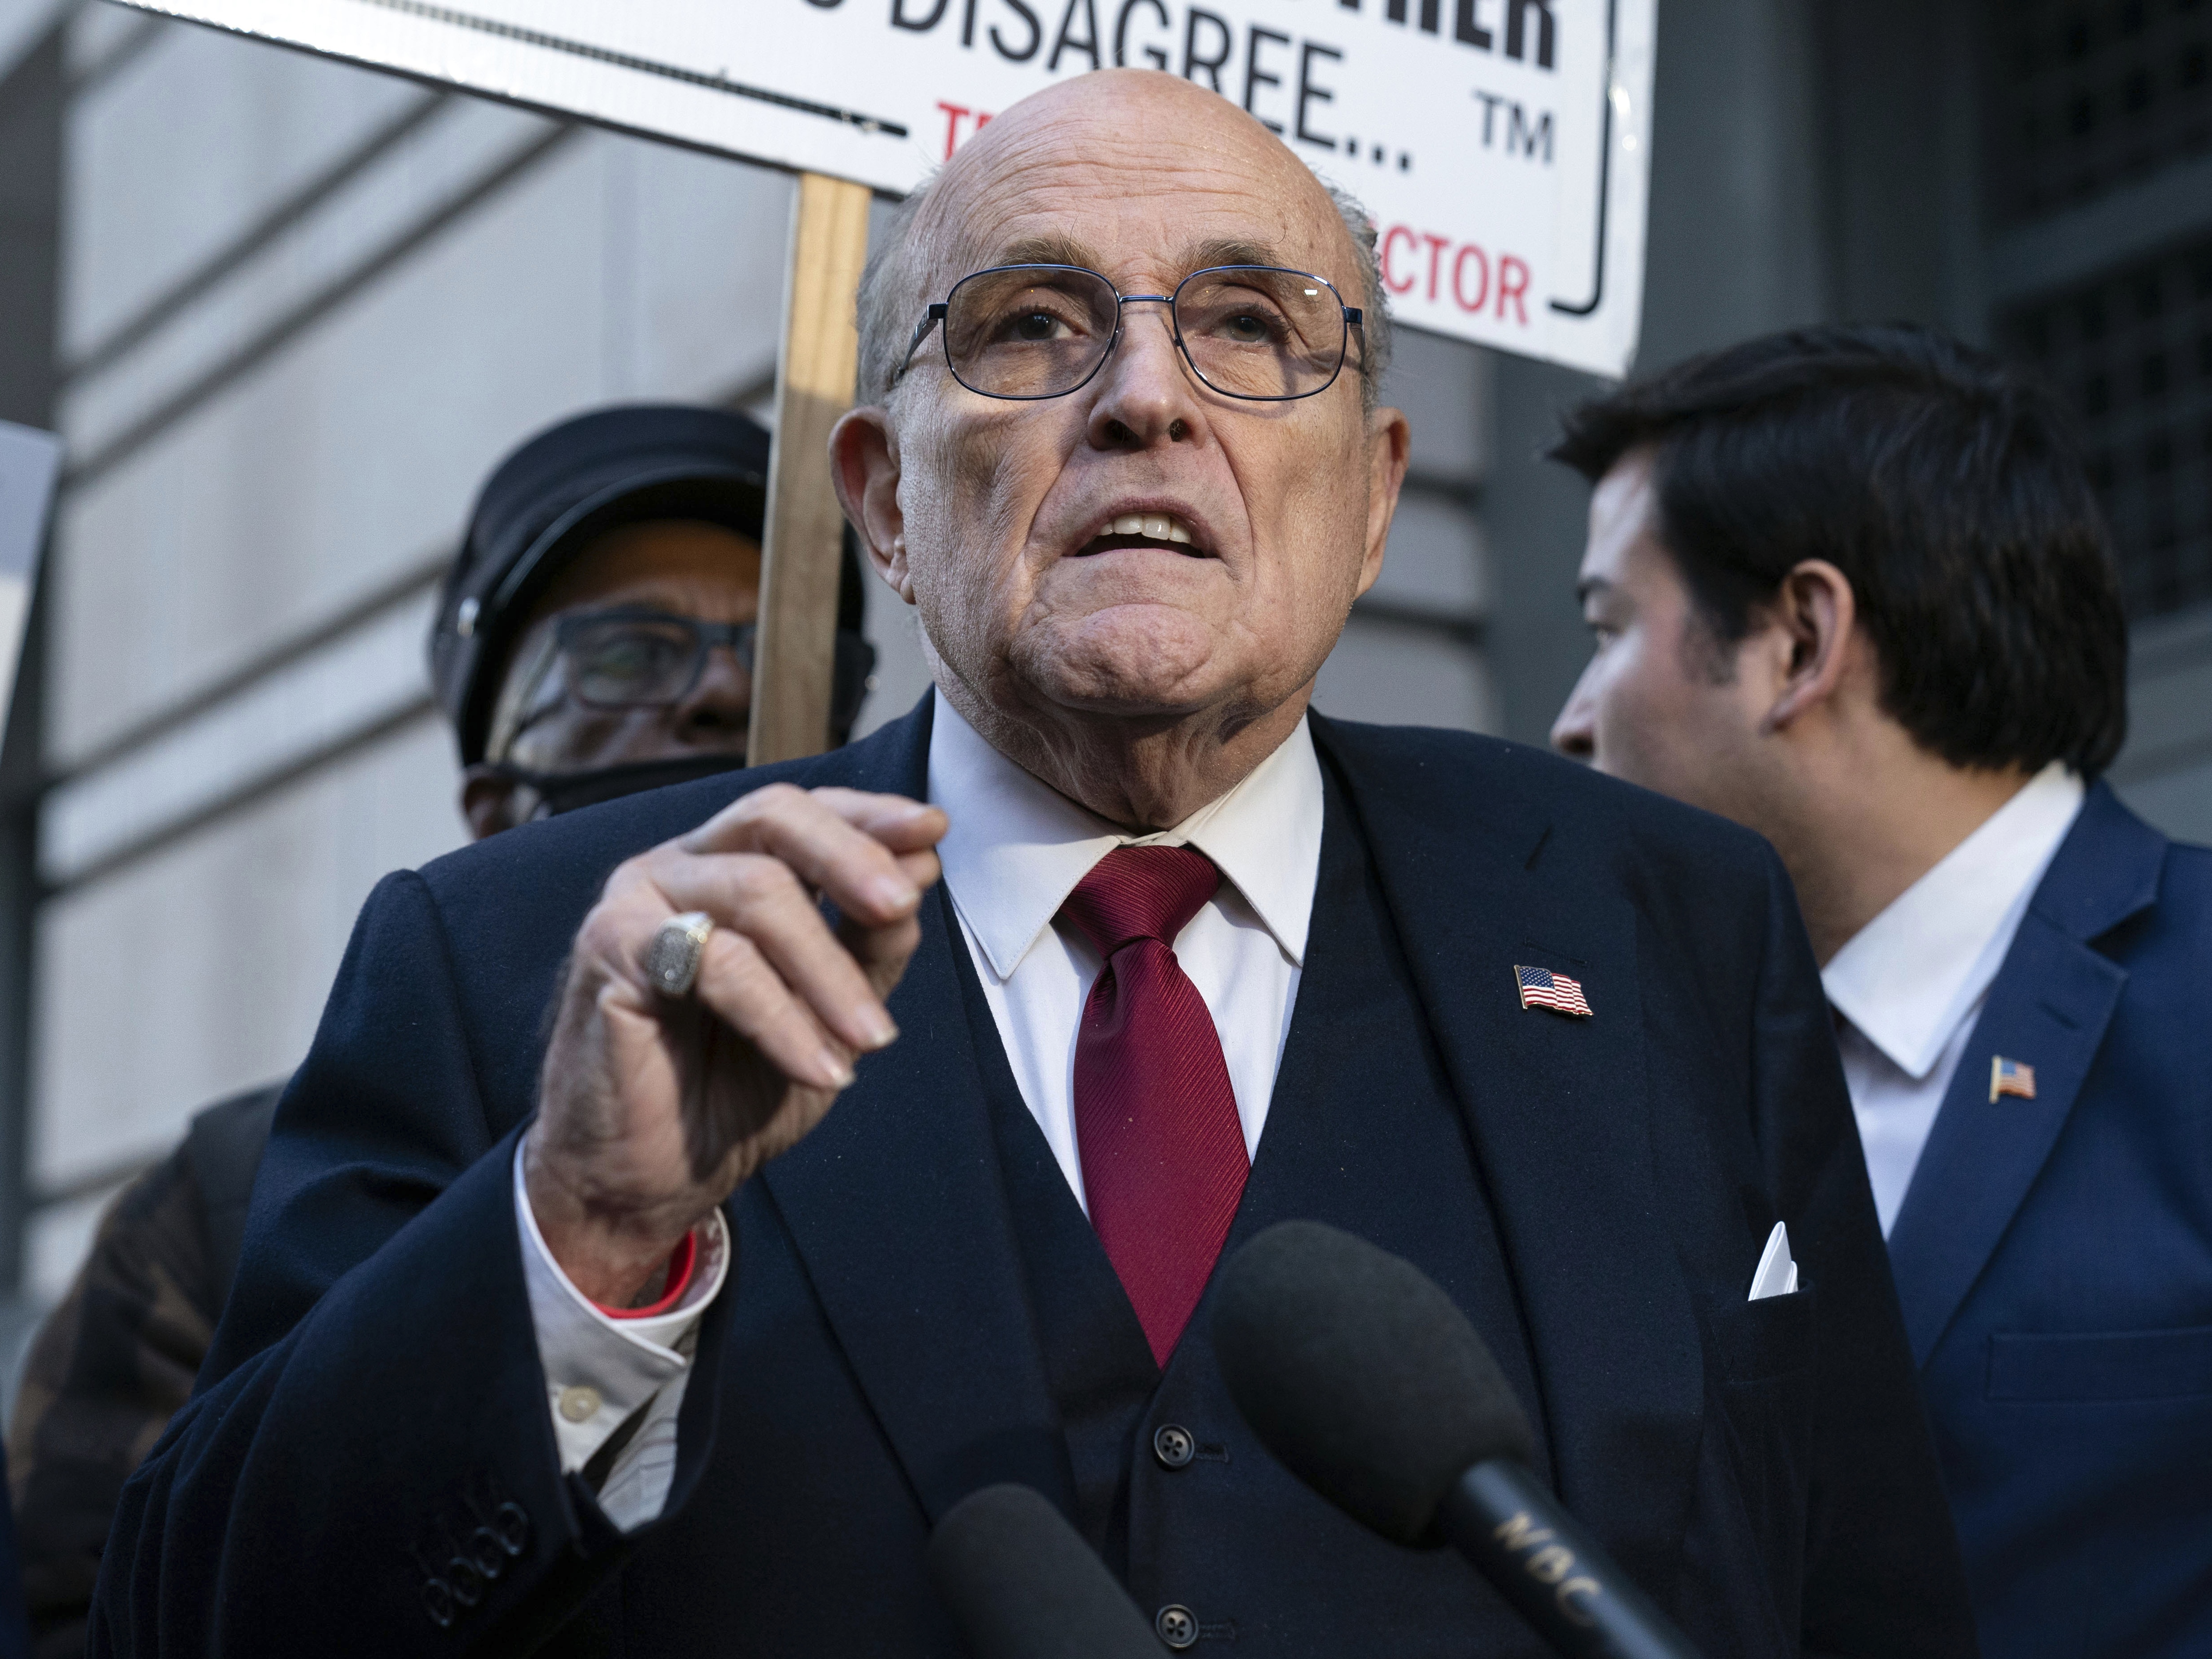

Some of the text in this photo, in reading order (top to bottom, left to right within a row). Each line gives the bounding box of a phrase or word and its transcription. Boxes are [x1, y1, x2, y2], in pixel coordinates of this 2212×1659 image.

[892, 0, 1410, 171] SAGREE...
[1472, 88, 1553, 165] TM
[1370, 214, 1530, 324] CTOR
